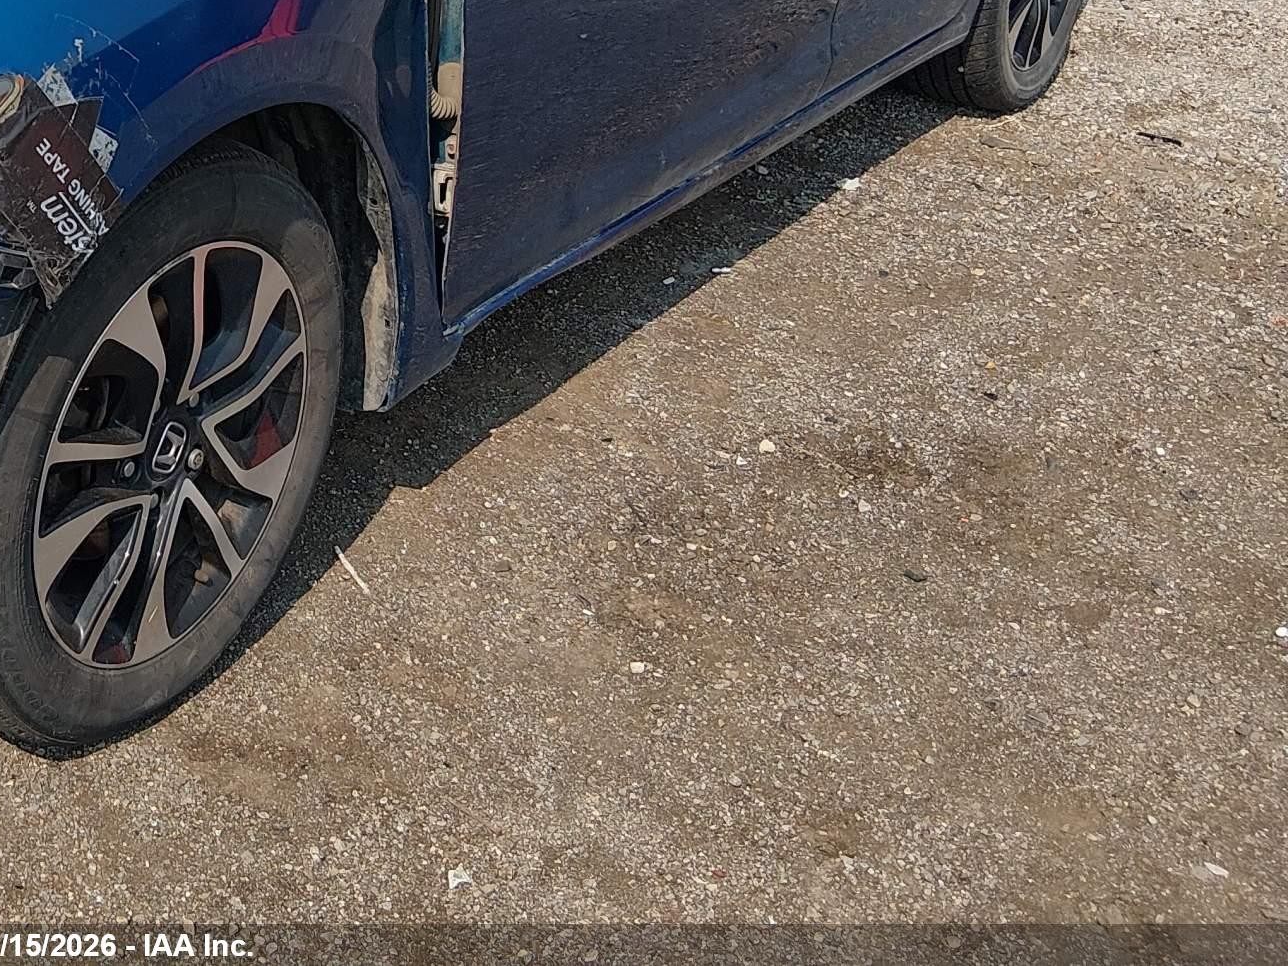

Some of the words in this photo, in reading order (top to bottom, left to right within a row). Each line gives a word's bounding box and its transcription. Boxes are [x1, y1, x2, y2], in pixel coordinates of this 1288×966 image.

[35, 137, 71, 184] TAPE
[40, 195, 94, 252] stem
[67, 178, 110, 236] ASHING
